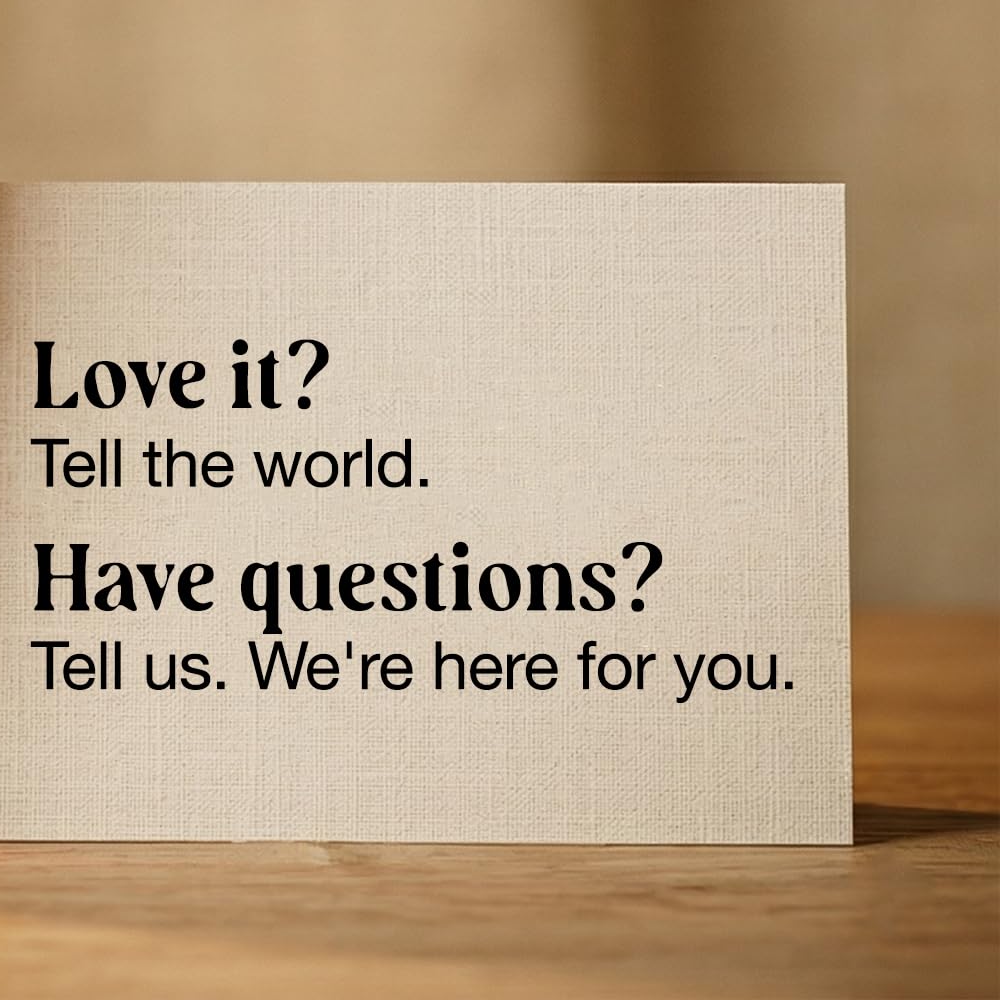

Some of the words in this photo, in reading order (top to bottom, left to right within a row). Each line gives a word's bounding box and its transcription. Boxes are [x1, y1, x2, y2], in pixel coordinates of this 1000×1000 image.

[33, 341, 206, 409] Love
[231, 338, 330, 410] it?
[30, 438, 122, 488] Tell
[142, 438, 234, 488] the
[253, 438, 429, 488] world.
[33, 543, 215, 612] Have
[239, 541, 664, 635] questions?
[30, 640, 122, 691] Tell
[146, 653, 226, 691] us.
[247, 640, 414, 691] We're
[435, 640, 559, 691] here
[576, 640, 657, 691] for
[673, 653, 794, 704] you.
